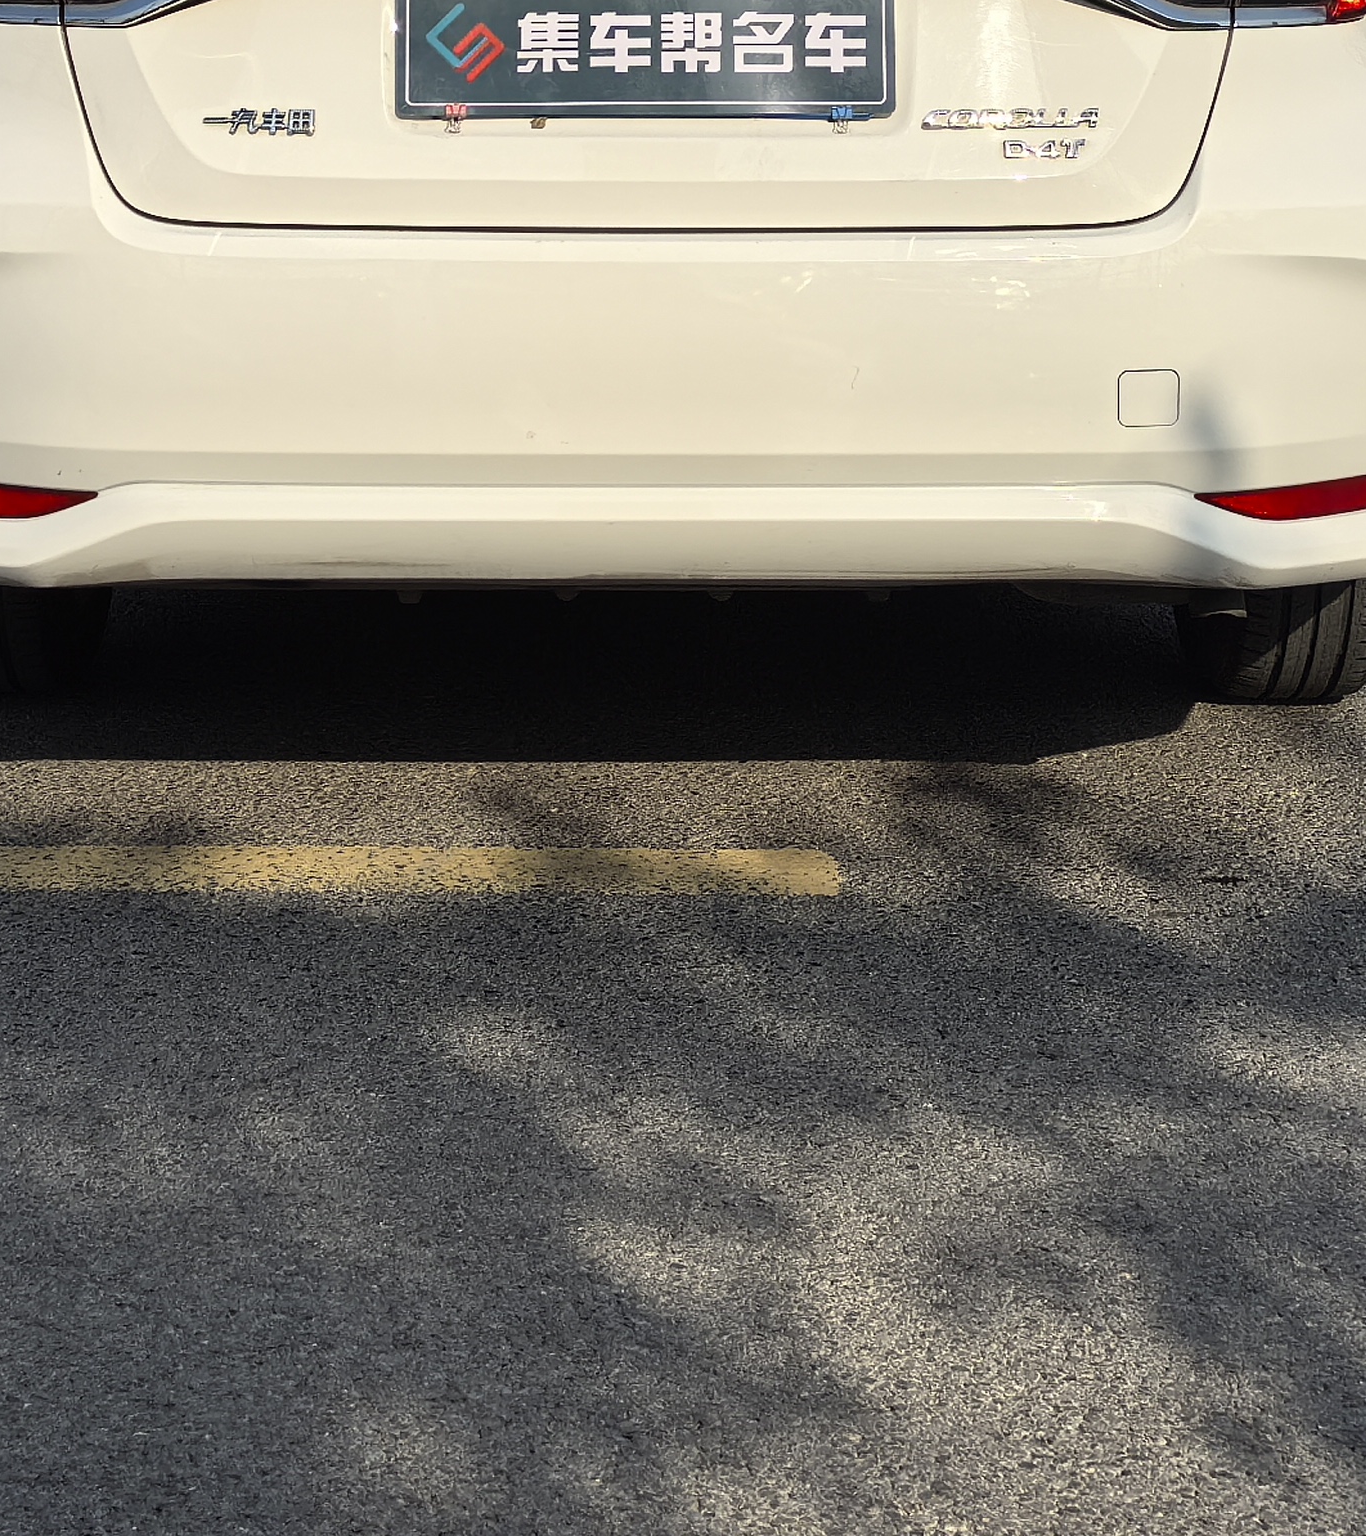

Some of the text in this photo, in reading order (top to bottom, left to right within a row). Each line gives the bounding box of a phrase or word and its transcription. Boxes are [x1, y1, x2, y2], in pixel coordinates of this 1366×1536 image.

[516, 11, 867, 73] 集车帮名车
[202, 107, 316, 136] 一汽丰田
[921, 108, 1099, 130] COROLLA
